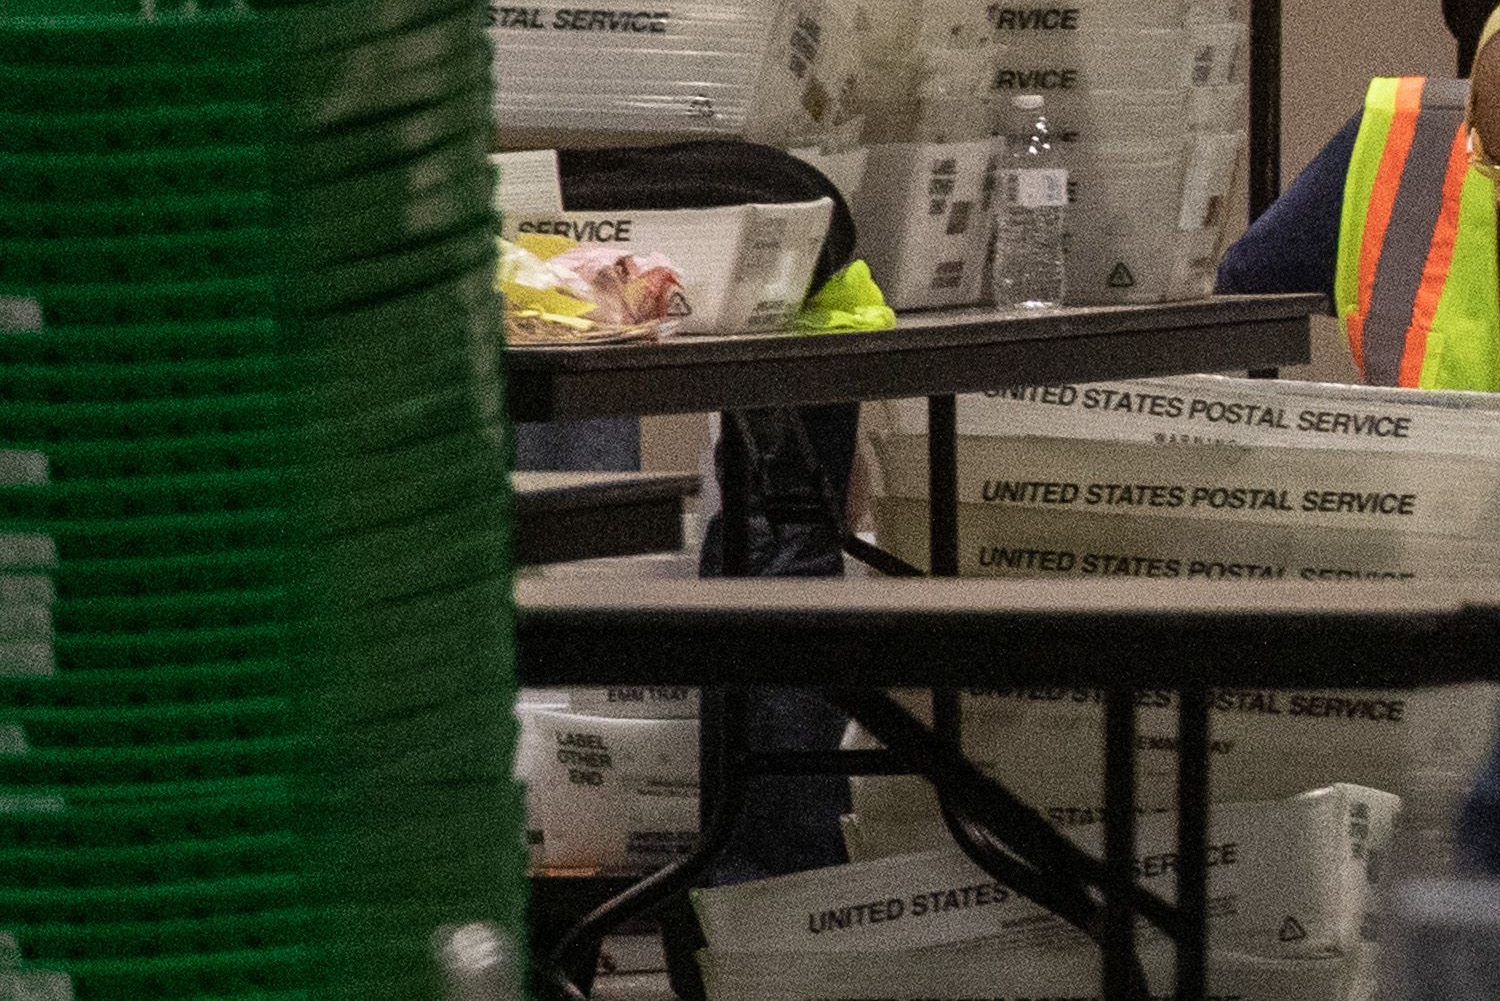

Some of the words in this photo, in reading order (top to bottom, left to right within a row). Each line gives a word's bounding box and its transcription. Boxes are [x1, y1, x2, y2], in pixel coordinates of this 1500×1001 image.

[553, 8, 669, 33] SERVICE
[996, 8, 1078, 30] RVICE
[996, 69, 1077, 90] RVICE
[1083, 389, 1183, 418] STATES
[1188, 400, 1291, 429] POSTAL
[1297, 410, 1410, 438] SERVICE
[982, 480, 1078, 505] UNITED
[1085, 484, 1186, 508] STATES
[1190, 487, 1294, 512] POSTAL
[1301, 491, 1416, 516] SERVICE
[978, 546, 1075, 572] UNITED
[1083, 553, 1181, 579] STATES
[1289, 698, 1406, 722] SERVICE
[556, 731, 608, 751] LABEL
[557, 749, 612, 768] OTHER
[569, 768, 604, 786] END
[808, 899, 904, 934] UNITED
[912, 881, 1008, 916] STATES
